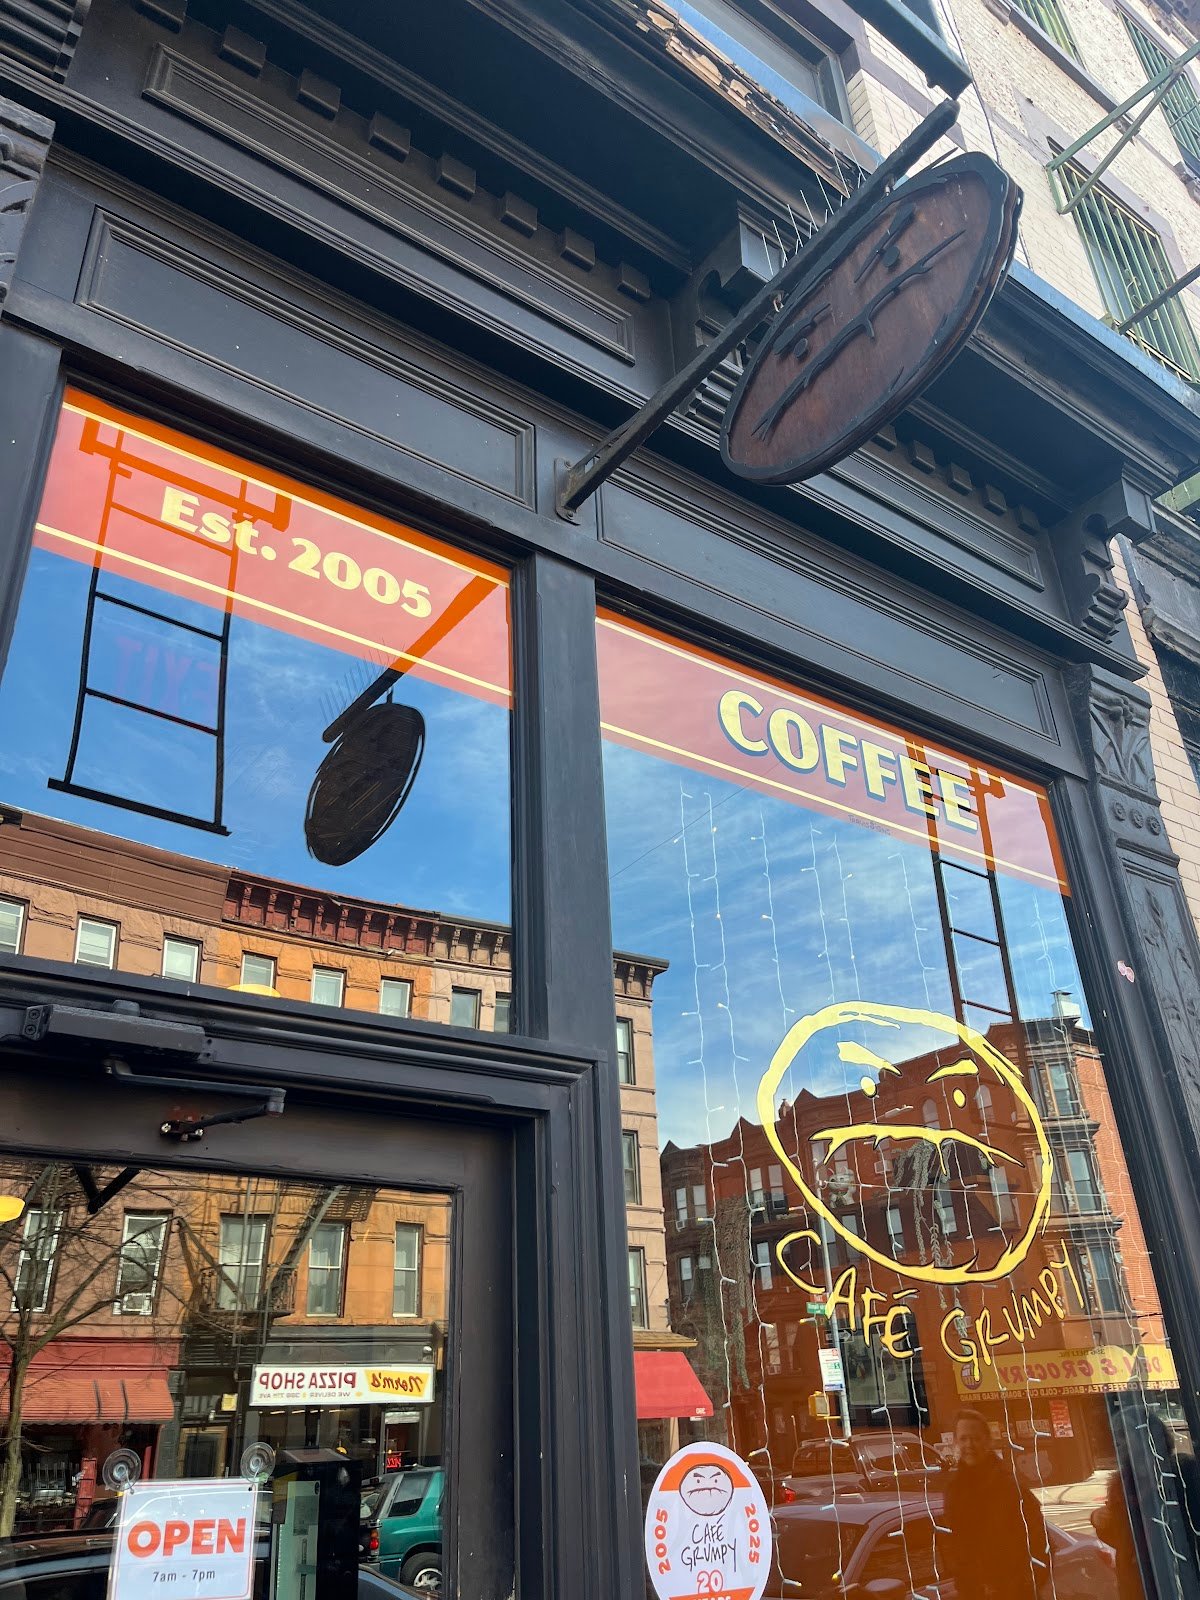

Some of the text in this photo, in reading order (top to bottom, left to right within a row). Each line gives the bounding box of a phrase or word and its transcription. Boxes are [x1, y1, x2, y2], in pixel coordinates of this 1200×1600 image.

[160, 485, 432, 619] Est. 2005
[718, 689, 978, 831] COFFEE
[775, 1229, 1085, 1381] CAFÉ GRUMPY
[127, 1517, 247, 1559] OPEN
[654, 1508, 672, 1575] 2005
[691, 1513, 726, 1545] CAFÉ
[744, 1503, 761, 1564] 2025
[153, 1571, 177, 1583] 7am
[192, 1569, 216, 1582] 7pm
[681, 1538, 737, 1572] GRUMPY
[697, 1569, 724, 1594] 20
